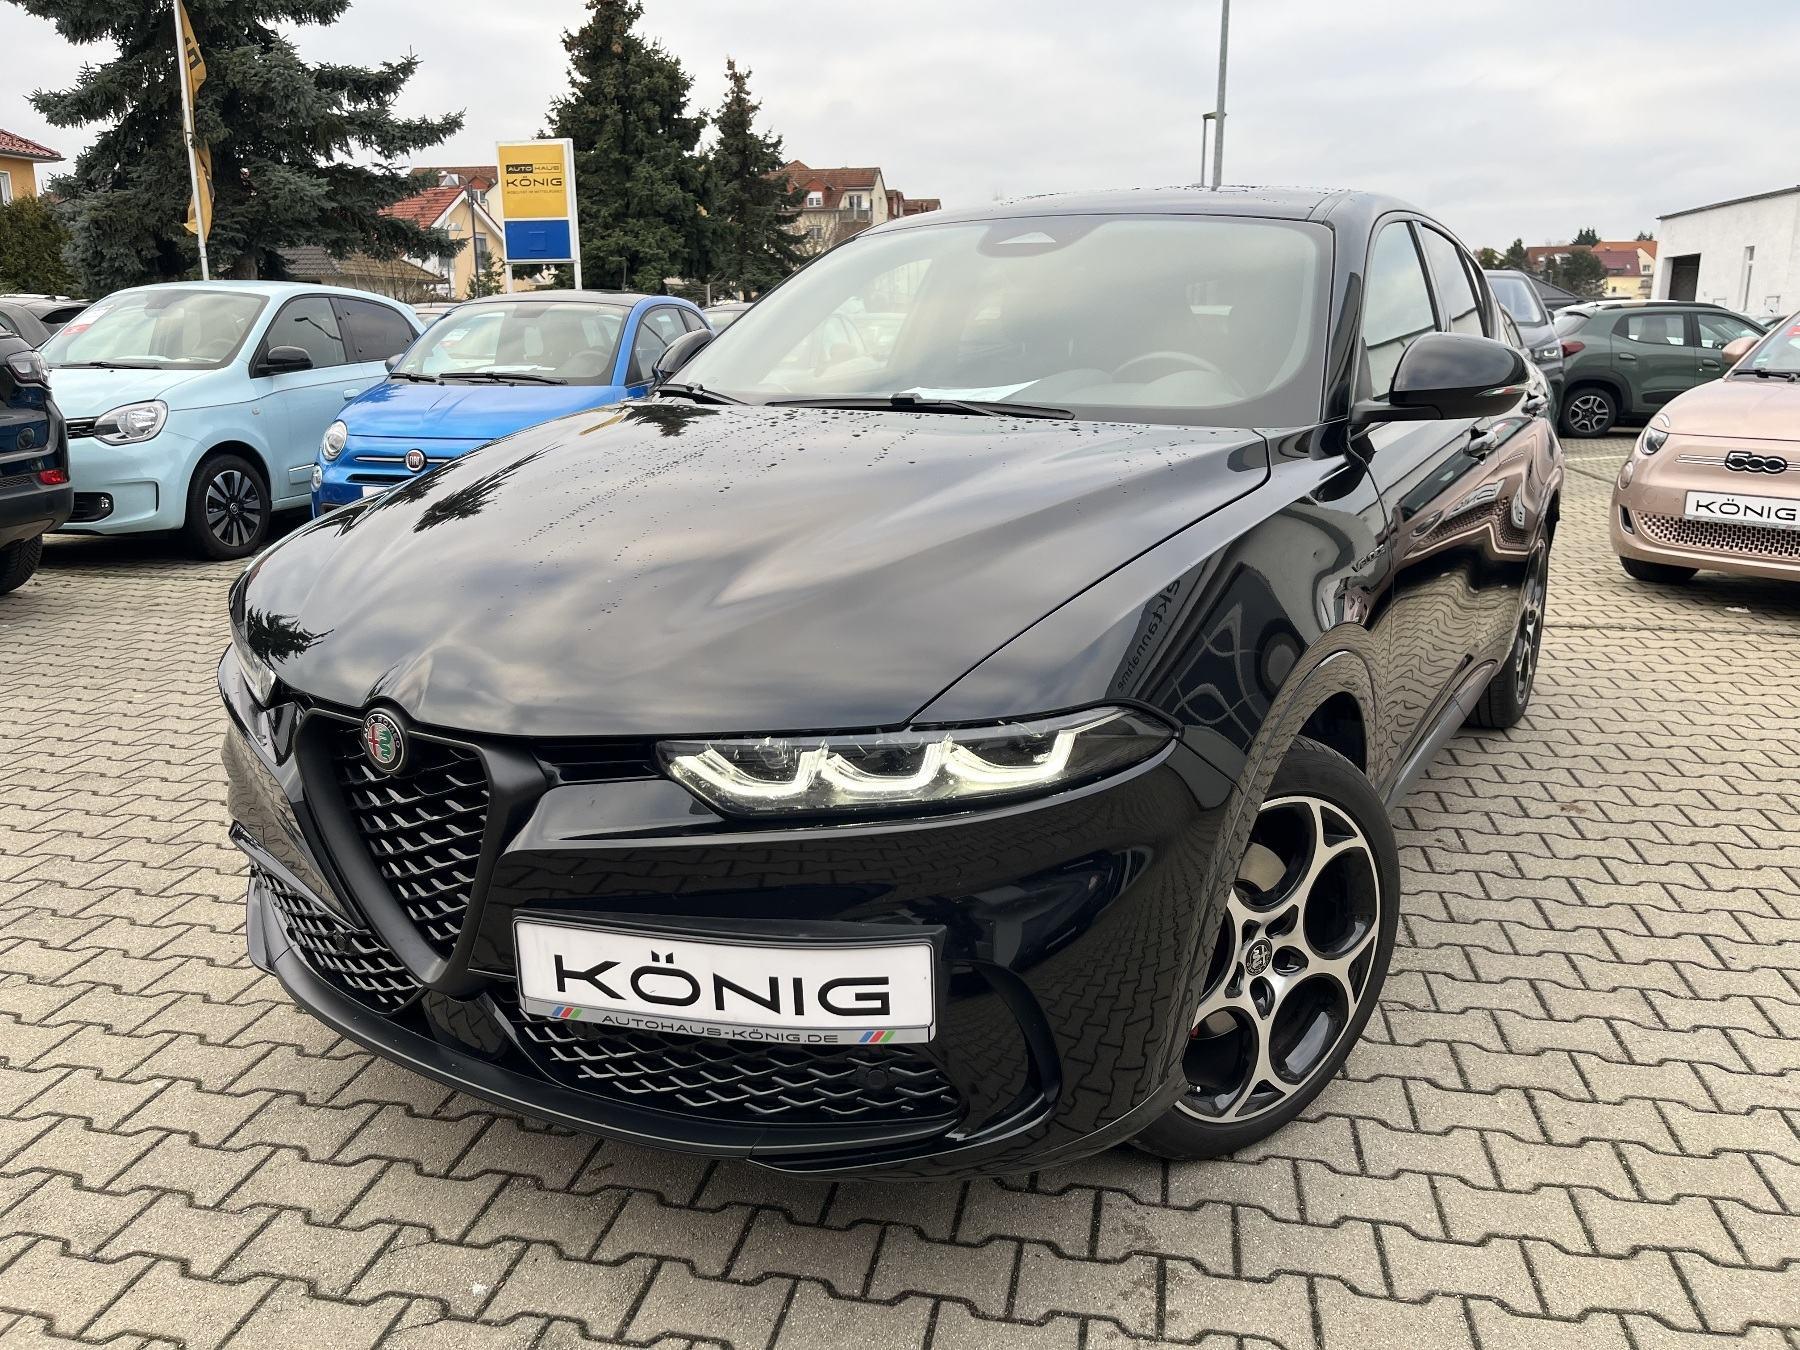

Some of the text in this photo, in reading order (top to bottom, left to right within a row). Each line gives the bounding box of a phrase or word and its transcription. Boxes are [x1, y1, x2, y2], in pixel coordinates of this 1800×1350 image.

[506, 175, 562, 188] KÖNIG
[1725, 451, 1788, 474] 500
[1695, 498, 1797, 522] KÖNIG
[553, 949, 891, 1017] KÖNIG
[601, 1014, 840, 1044] AUTOHAUS-KÖNIG.DE
